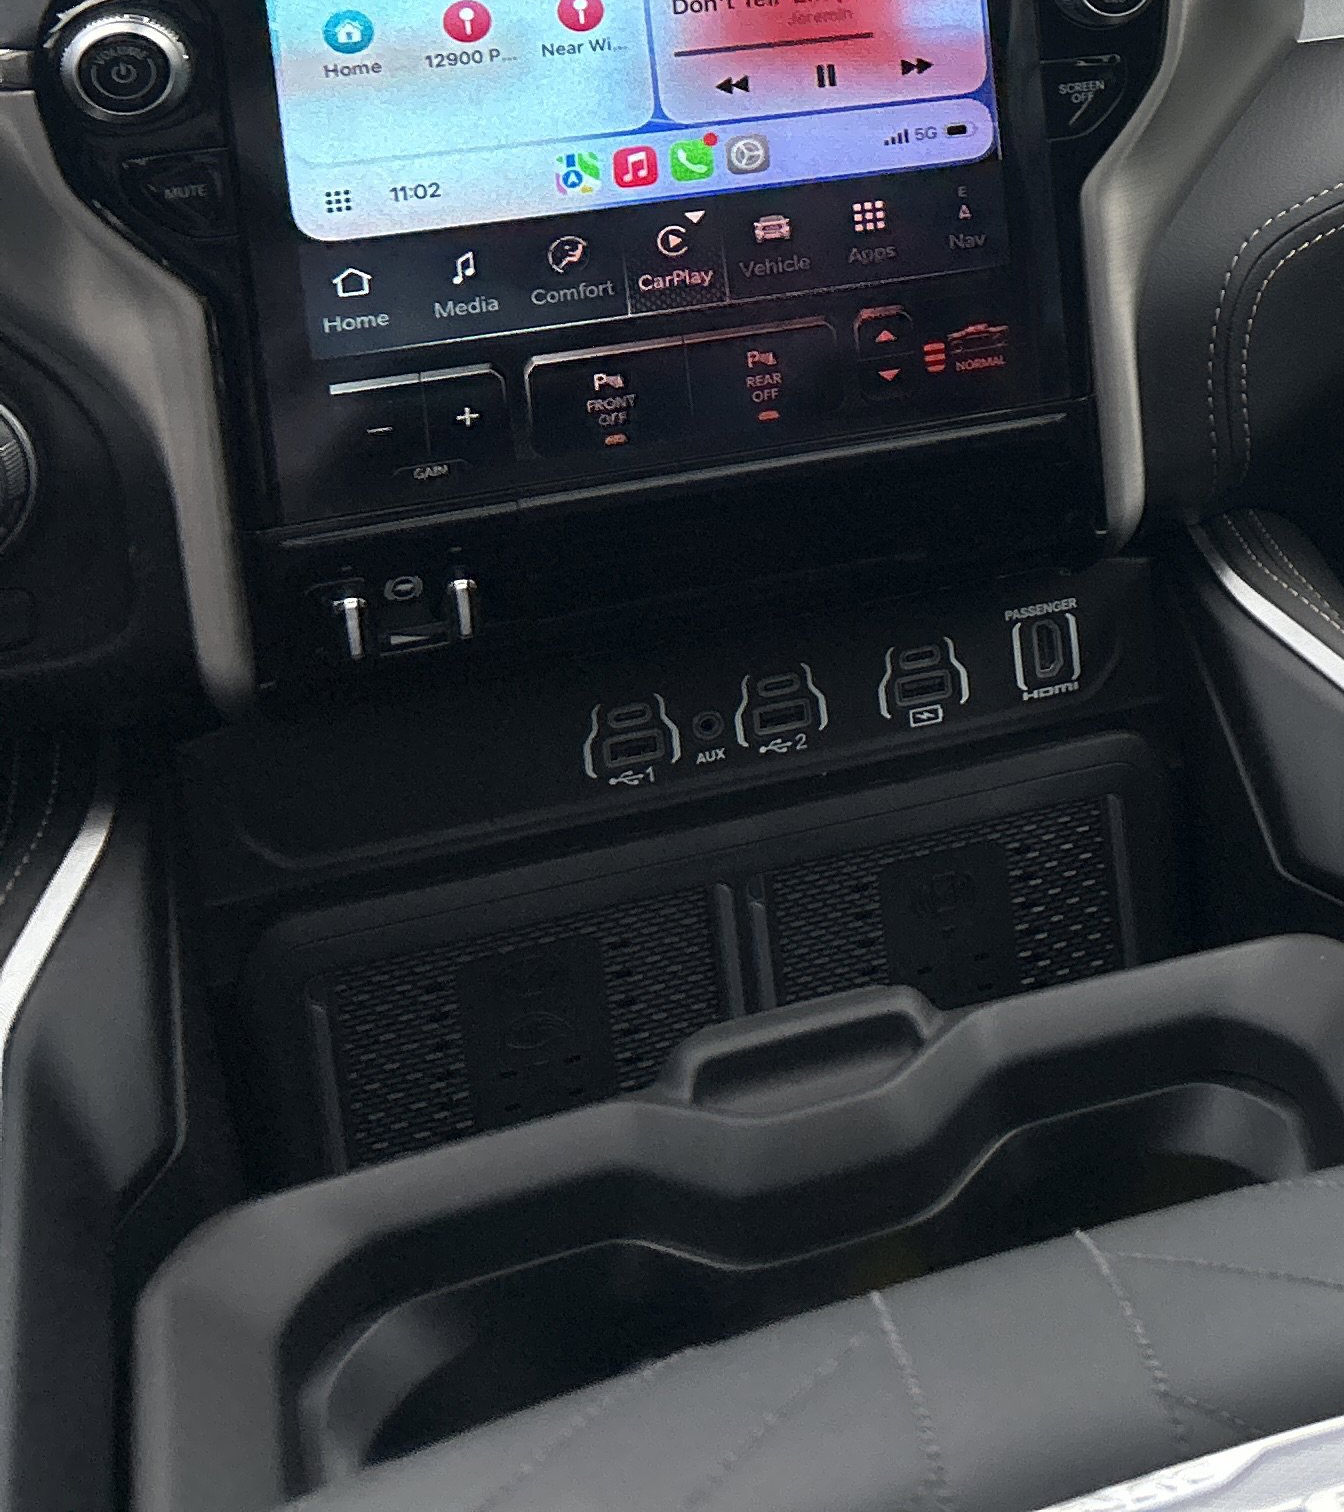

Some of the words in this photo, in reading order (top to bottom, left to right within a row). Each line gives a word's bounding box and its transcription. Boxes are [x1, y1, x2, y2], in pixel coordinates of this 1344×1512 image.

[541, 42, 583, 57] Near
[425, 50, 484, 69] 12900
[323, 61, 383, 78] Home
[1058, 80, 1105, 95] SCREEN
[1071, 91, 1095, 104] OFF
[915, 127, 938, 142] 5G
[165, 184, 209, 200] MUTE
[389, 182, 442, 203] 11:02
[957, 185, 968, 198] E
[949, 233, 987, 249] Nav
[847, 243, 897, 264] Apps
[739, 254, 812, 278] Vehicle
[638, 269, 714, 293] CarPlay
[530, 280, 616, 306] Comfort
[434, 296, 500, 320] Media
[323, 311, 390, 334] Home
[955, 354, 1007, 372] NORMAL
[746, 371, 783, 388] REAR
[587, 392, 637, 413] FRONT
[752, 386, 779, 403] OFF
[598, 410, 628, 428] OFF
[413, 464, 449, 480] GAIN
[1005, 597, 1078, 622] PASSENGER
[1022, 681, 1080, 701] HDMI
[795, 734, 808, 751] 2
[695, 747, 727, 765] AUX
[645, 767, 656, 783] 1
